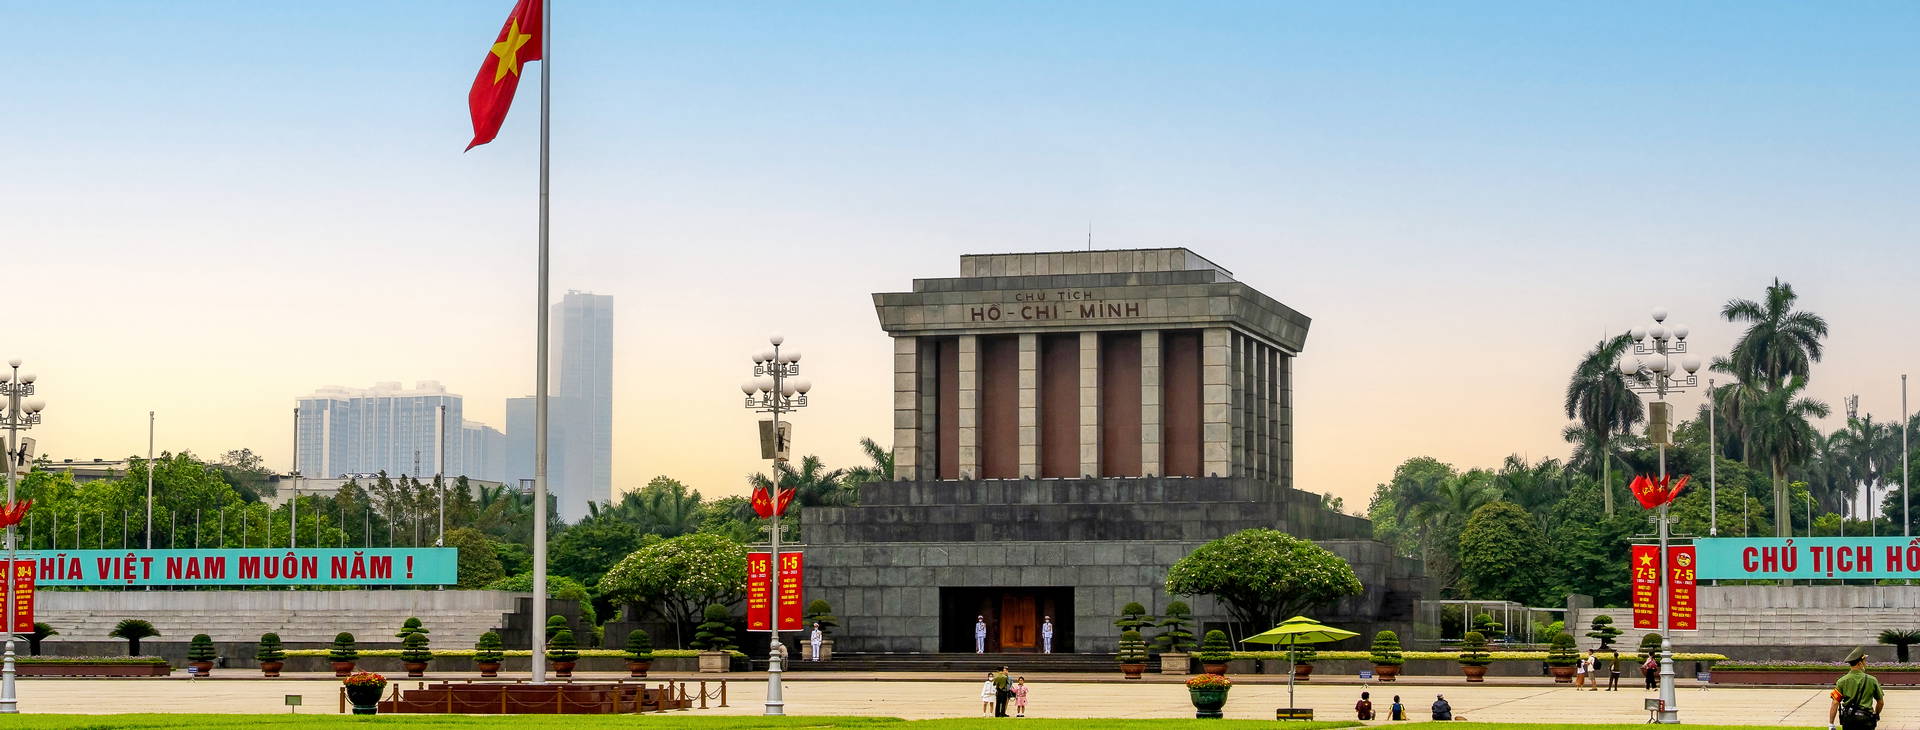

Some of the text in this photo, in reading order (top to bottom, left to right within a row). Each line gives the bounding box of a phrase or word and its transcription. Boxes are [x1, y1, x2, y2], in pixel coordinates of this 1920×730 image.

[783, 557, 798, 569] 1-5
[1743, 539, 1797, 573] CHỦ
[1810, 546, 1873, 578] TỊCH
[17, 566, 32, 577] 30-4
[26, 553, 83, 580] HĨA
[97, 552, 153, 584] VIỆT
[166, 556, 226, 580] NAM
[238, 551, 318, 580] MUÔN
[331, 551, 392, 580] NĂM
[751, 560, 766, 573] 1-5
[1636, 568, 1656, 579] 7-5
[1674, 568, 1693, 580] 7-5
